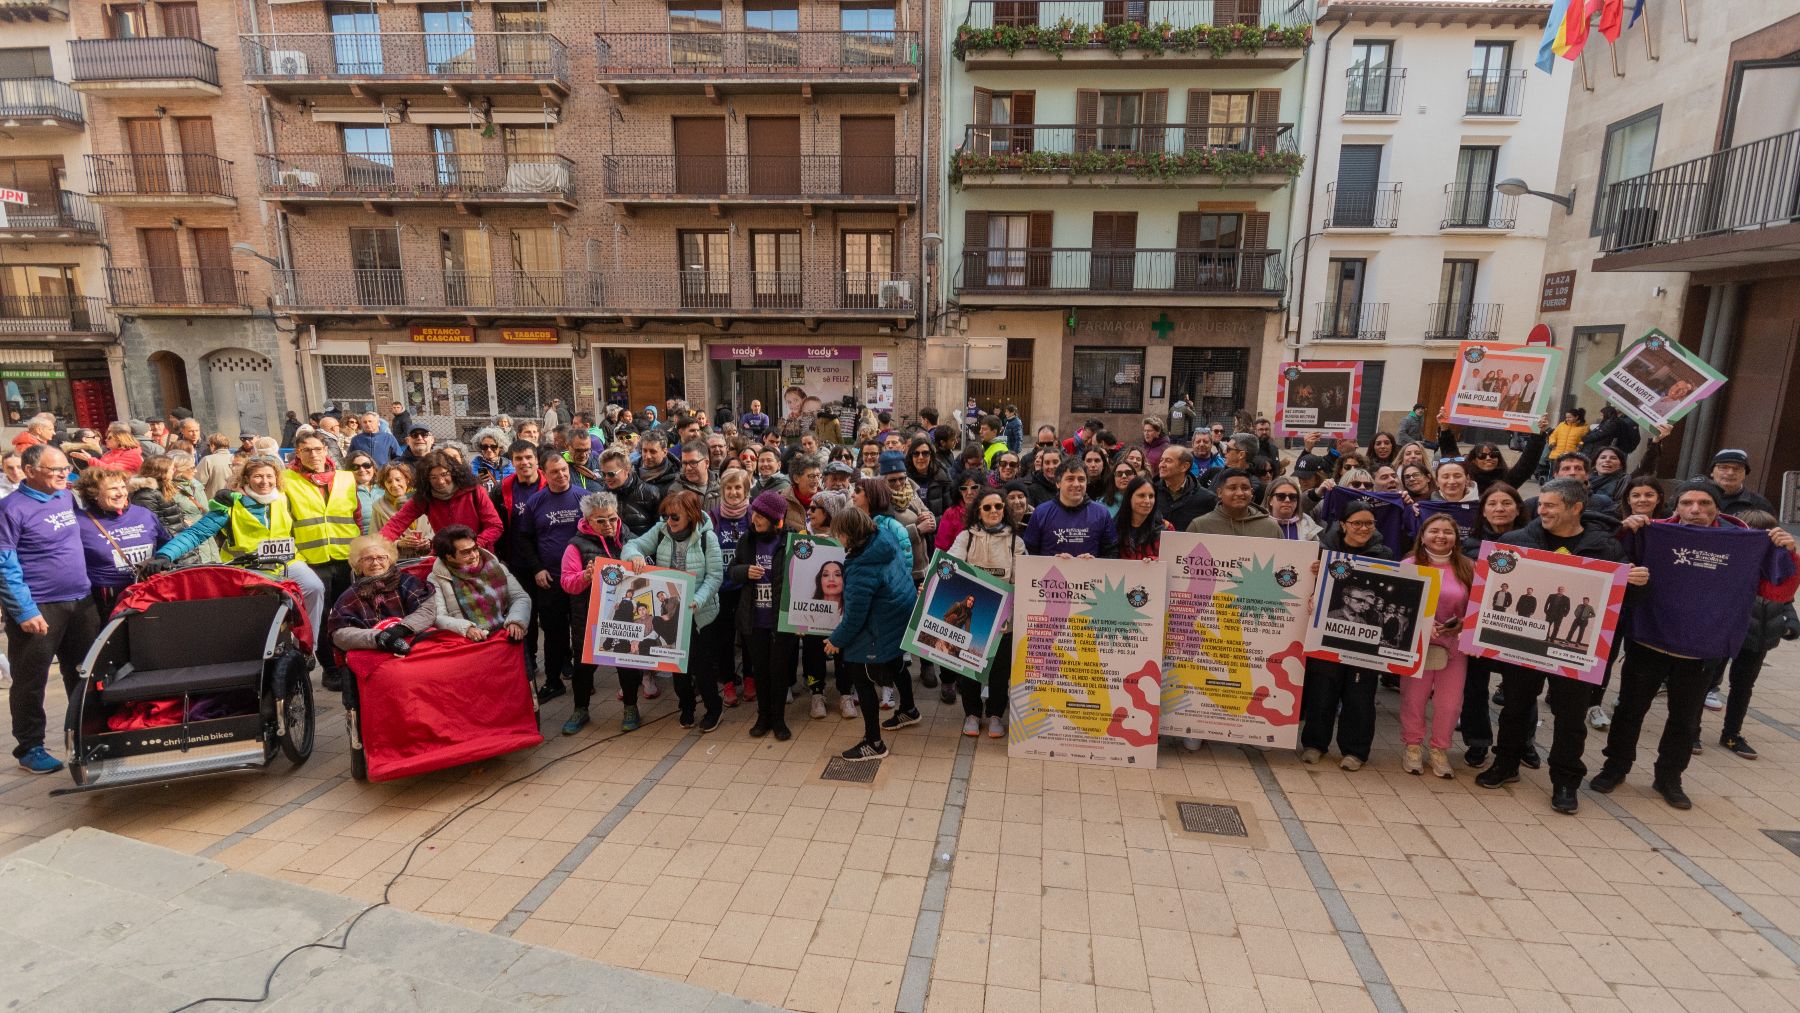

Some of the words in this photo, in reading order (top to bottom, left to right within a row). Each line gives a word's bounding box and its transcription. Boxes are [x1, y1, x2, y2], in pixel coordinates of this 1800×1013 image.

[1546, 276, 1570, 286] PLAZA
[1544, 288, 1552, 296] DE
[1543, 298, 1567, 308] FUEROS
[1078, 320, 1145, 331] FARMACIA
[732, 346, 763, 357] trady's
[808, 347, 838, 358] trady's
[1612, 370, 1637, 390] ALCALÁ
[1634, 386, 1656, 402] NORTE
[1458, 392, 1472, 400] NIÑA
[1473, 394, 1498, 403] POLACA
[263, 543, 290, 554] 0044
[793, 601, 807, 611] LUZ
[810, 603, 833, 613] CASAL
[1489, 619, 1523, 632] ANIVERSARIO
[1492, 613, 1527, 626] HABITACIÓN
[1529, 621, 1546, 630] ROJA
[601, 622, 642, 633] SANGUIJUELAS
[923, 620, 948, 636] CARLOS
[948, 630, 965, 644] ARES
[1325, 622, 1356, 637] NACHA
[1358, 628, 1378, 639] POP
[612, 629, 639, 639] GUADIANA
[210, 731, 234, 740] bikes
